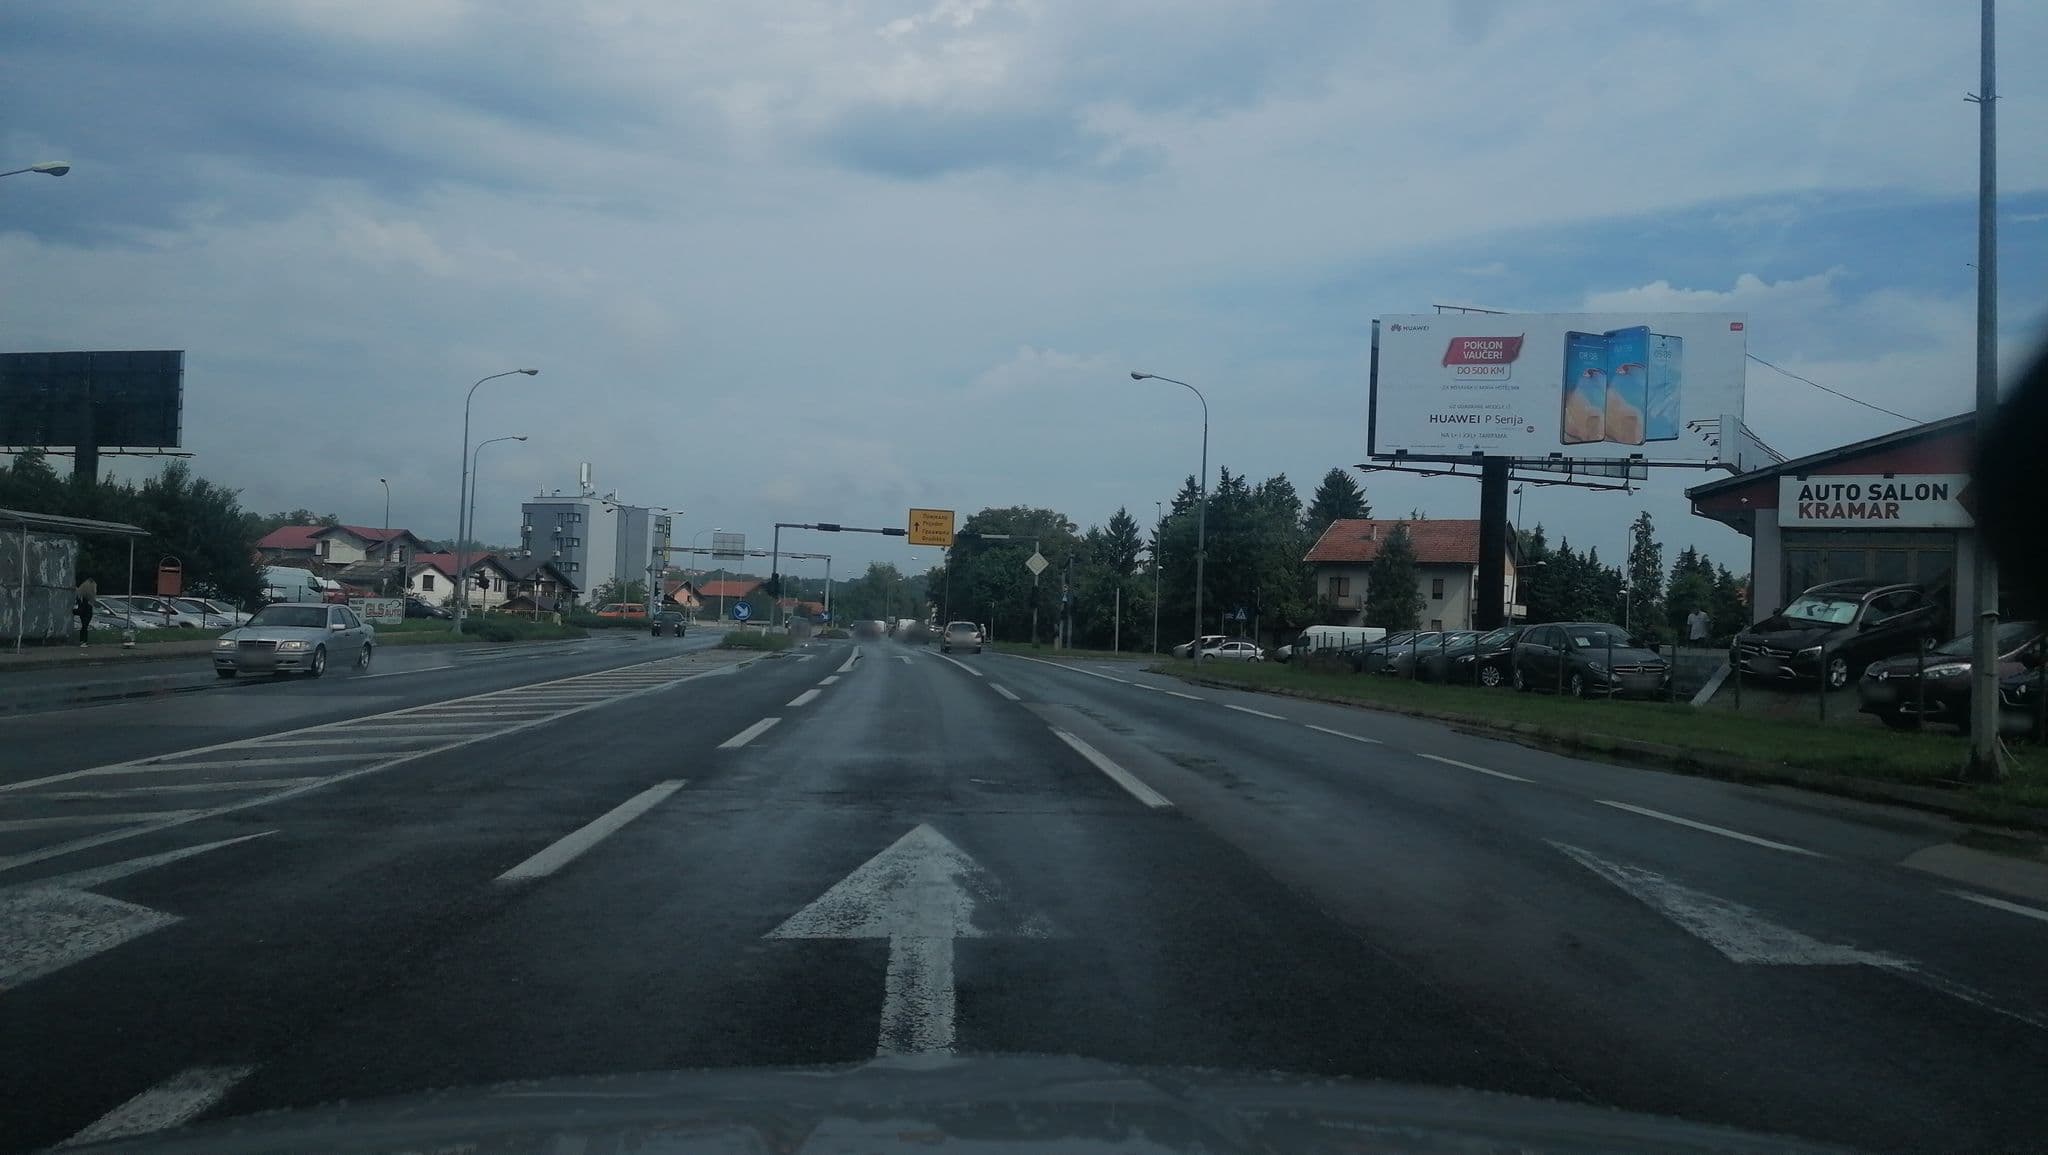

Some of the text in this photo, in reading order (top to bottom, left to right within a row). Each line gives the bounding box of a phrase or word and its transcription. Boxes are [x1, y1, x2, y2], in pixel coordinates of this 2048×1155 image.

[1464, 341, 1503, 349] POKLON
[1463, 349, 1503, 360] VAUČER!
[1457, 367, 1505, 375] DO 500 KM
[1429, 414, 1524, 426] HUAWEI P Serija
[1798, 483, 1949, 501] AUTO SALON
[1798, 502, 1900, 520] KRAMAR
